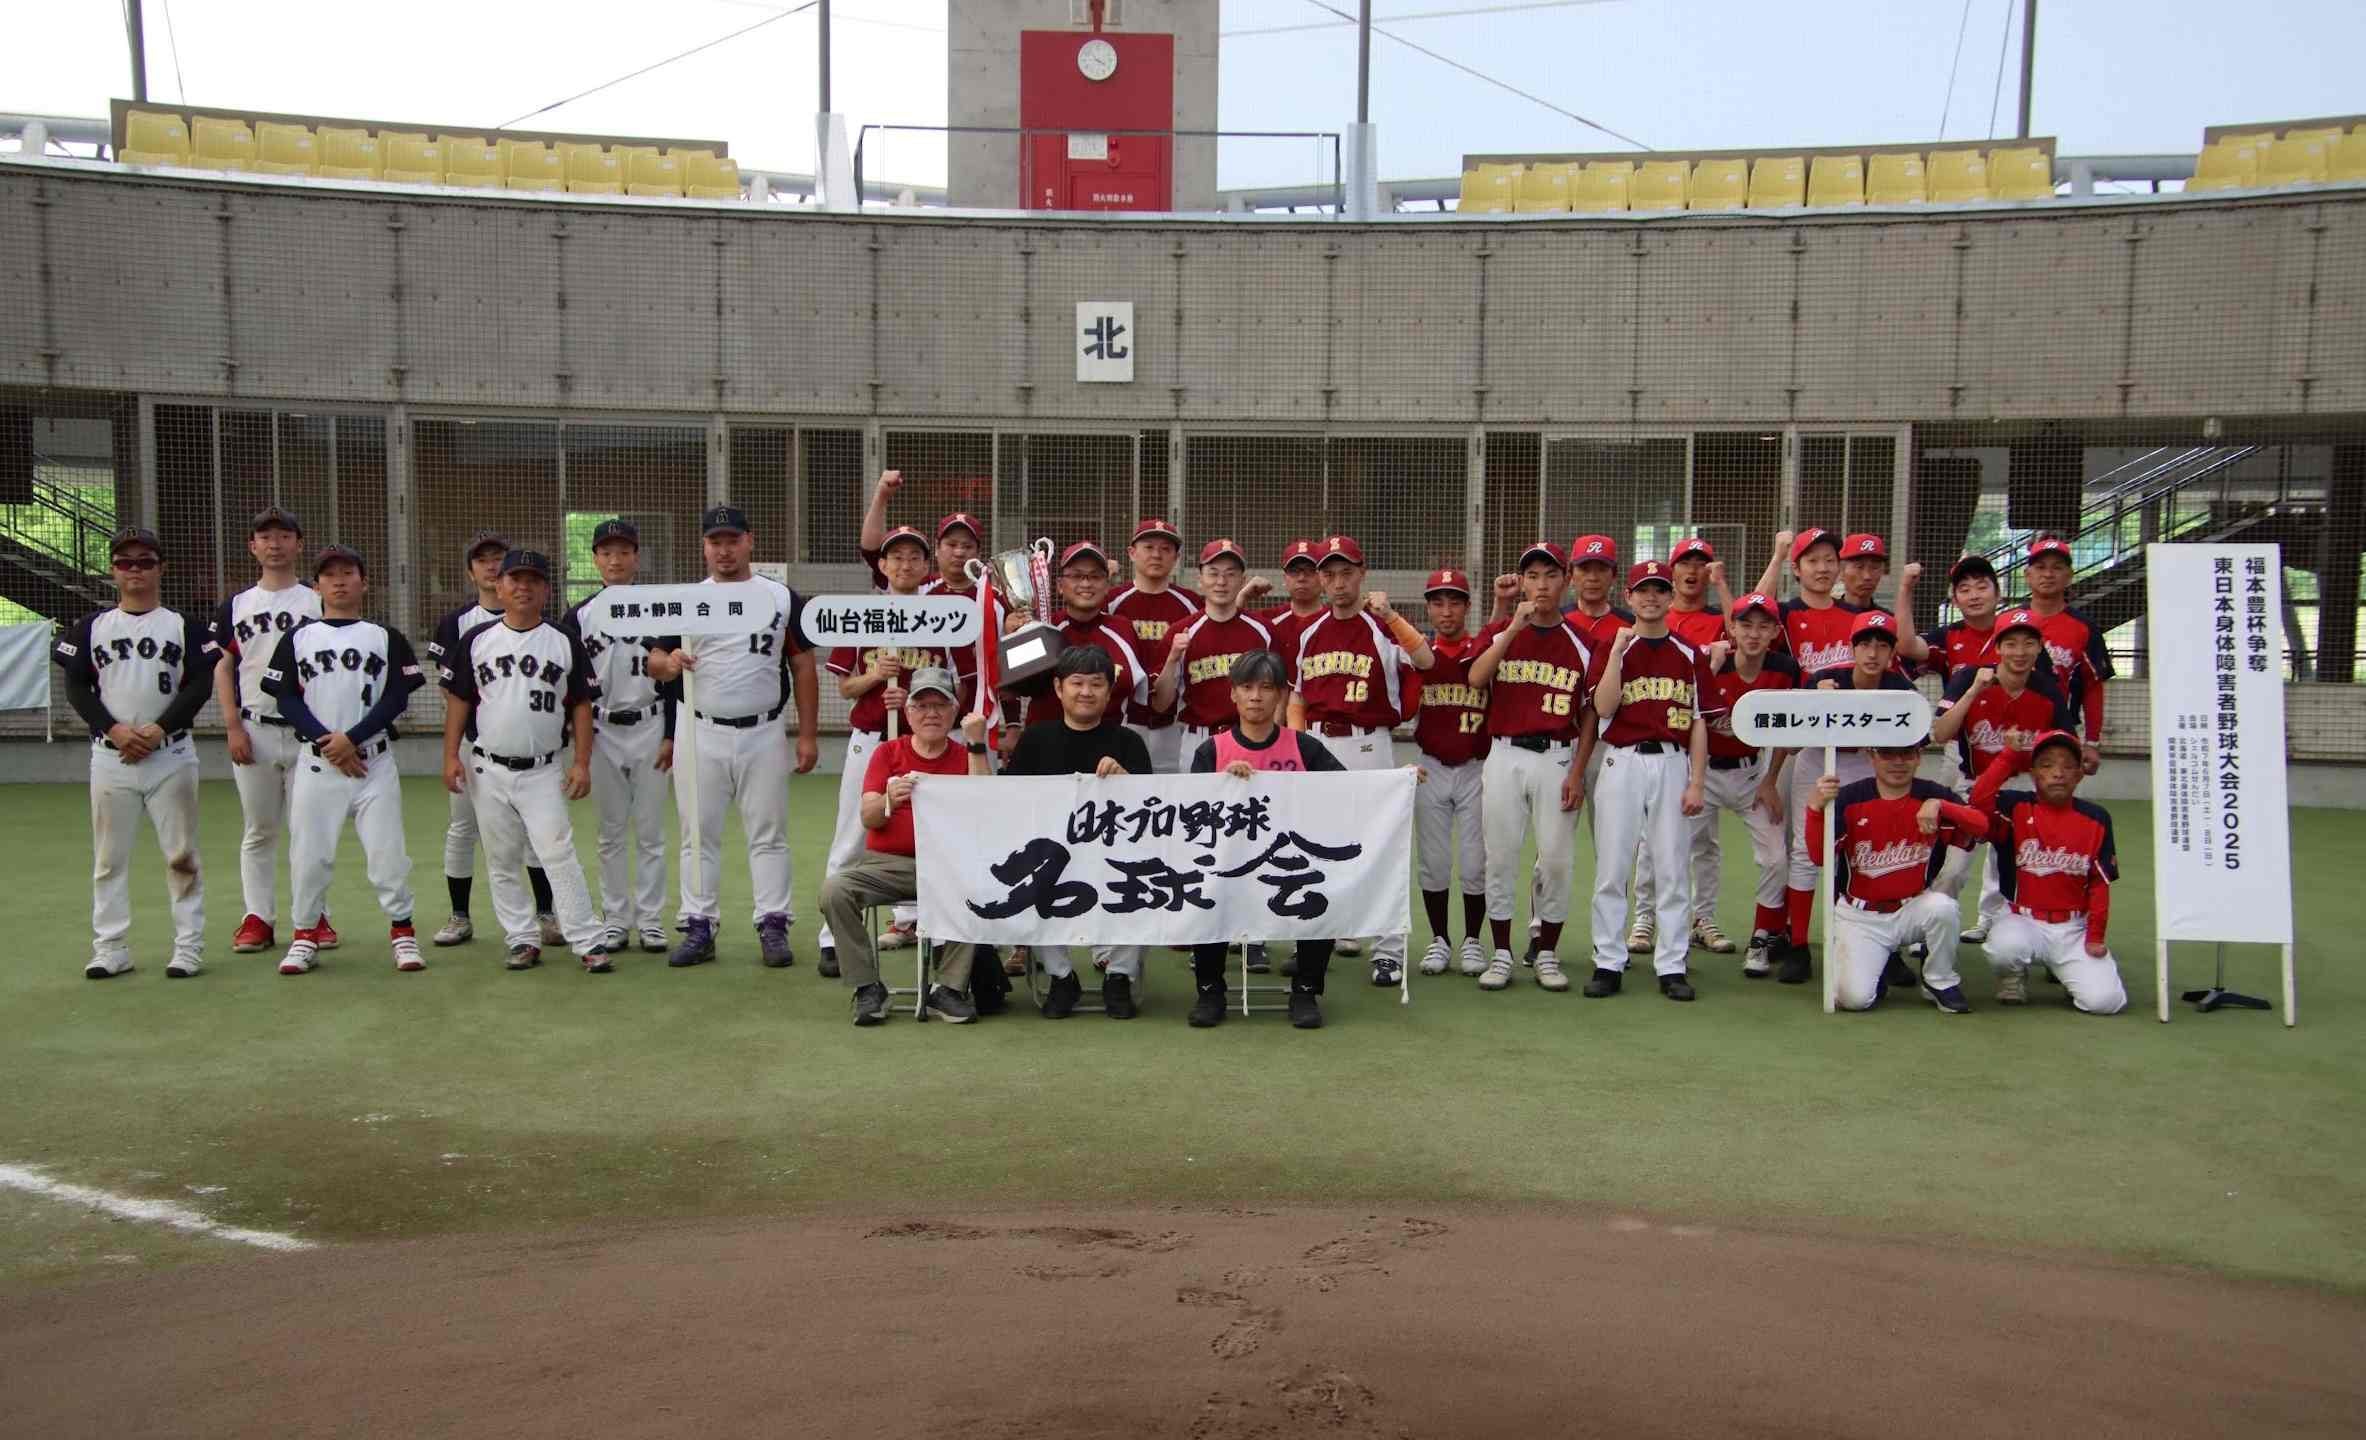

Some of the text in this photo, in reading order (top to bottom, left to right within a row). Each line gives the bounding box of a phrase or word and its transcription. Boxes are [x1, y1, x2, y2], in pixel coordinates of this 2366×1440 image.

[1083, 316, 1128, 360] 北
[610, 602, 682, 618] 群馬・静岡
[815, 608, 968, 634] 仙台福祉メッツ
[2246, 557, 2268, 672] 福本豊杯争奪
[749, 633, 775, 656] 12
[1302, 651, 1374, 681] SENDAI
[1497, 659, 1580, 692] SENDAI
[158, 671, 172, 695] 6
[529, 690, 556, 713] 30
[1422, 683, 1488, 709] ENDAI
[1541, 693, 1572, 716] 15
[1458, 711, 1484, 733] 17
[1667, 706, 1692, 730] 25
[1754, 712, 1912, 729] 信濃レッドスターズ
[1067, 796, 1271, 847] 日本プロ野球
[966, 831, 1362, 920] 名球会
